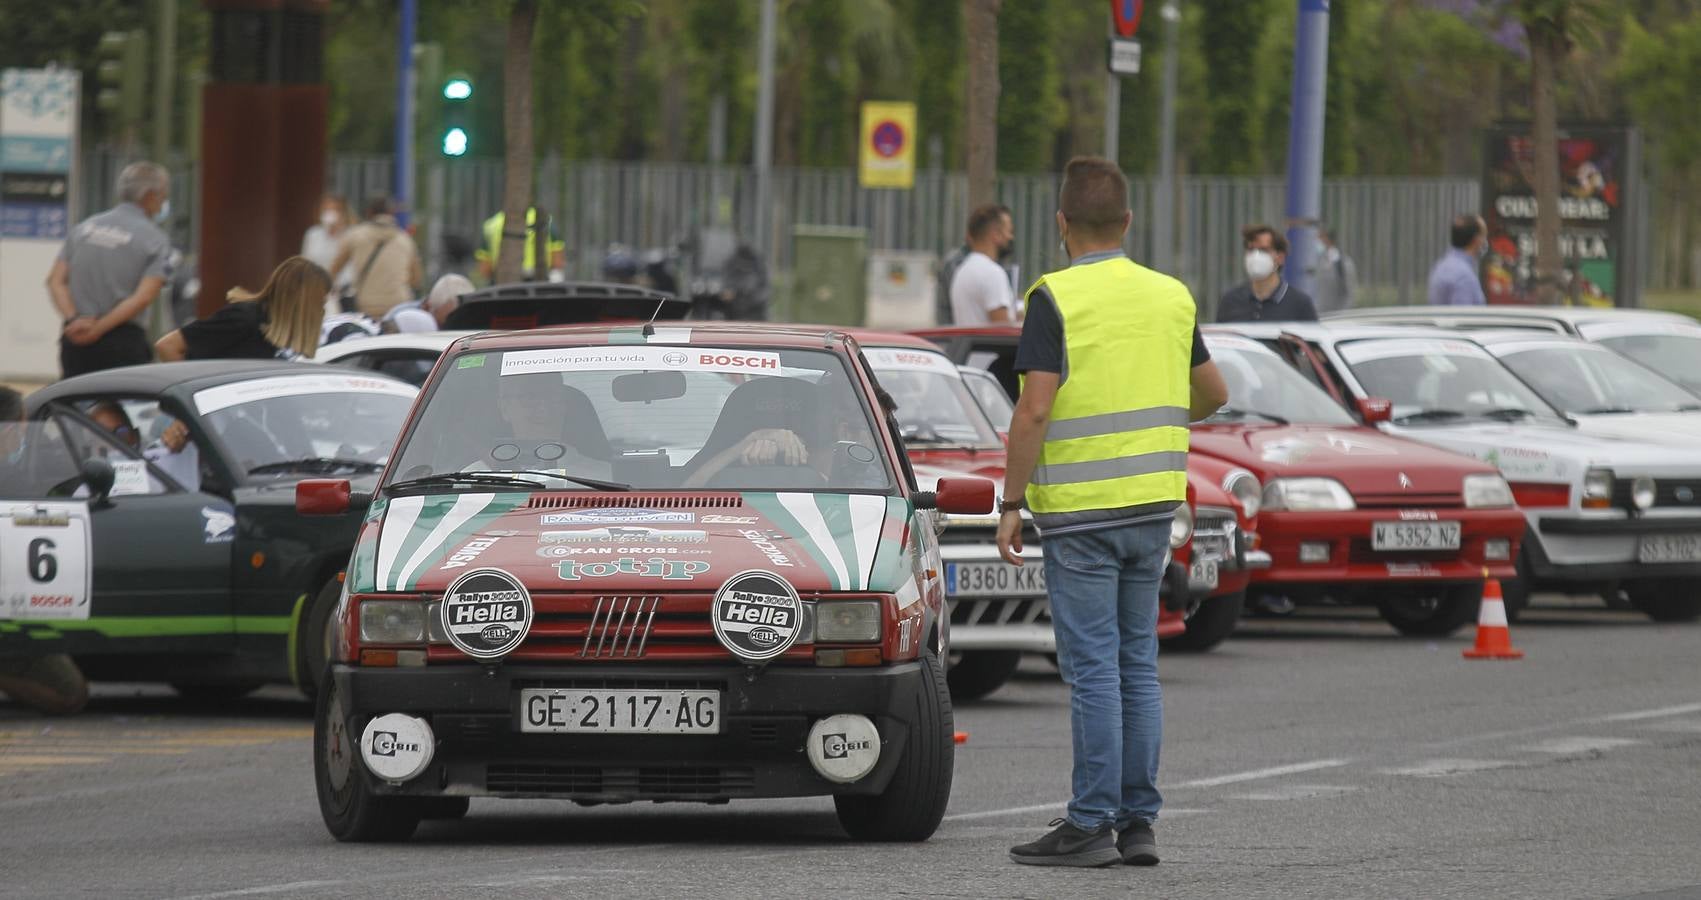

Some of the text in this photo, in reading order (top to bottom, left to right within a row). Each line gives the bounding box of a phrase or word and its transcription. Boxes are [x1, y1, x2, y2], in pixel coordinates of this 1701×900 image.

[504, 353, 777, 369] Innovación para tu vida BOSCH
[1376, 527, 1457, 546] M 5352 NZ
[439, 537, 501, 570] TEMSA
[554, 547, 612, 555] GRAN
[28, 537, 58, 585] 6
[551, 557, 711, 581] totip
[960, 566, 1008, 591] 8360
[30, 595, 73, 607] BOSCH
[459, 591, 520, 603] Rallye 3000
[732, 591, 794, 607] Rallye 3000
[455, 603, 518, 624] Hella
[726, 603, 789, 626] Hella
[381, 742, 419, 752] CIBIE
[832, 741, 870, 751] CIBIE
